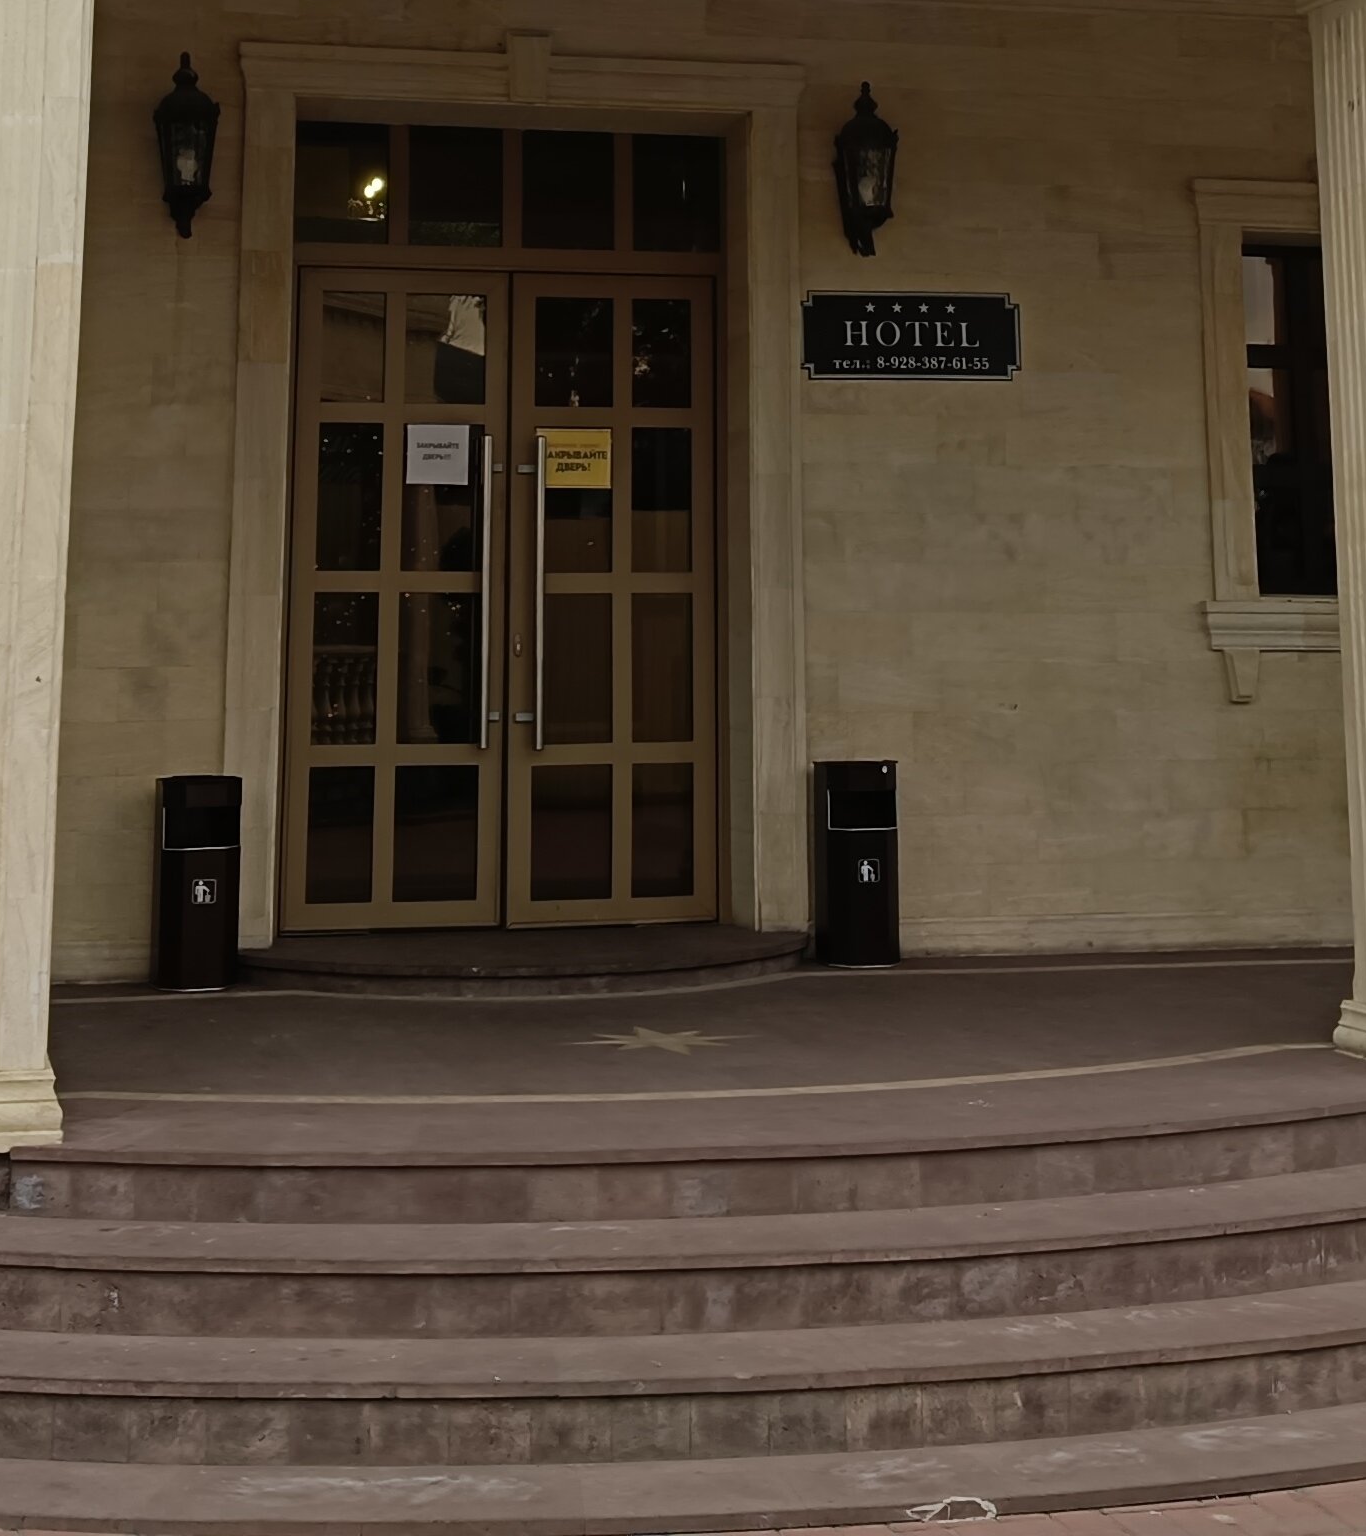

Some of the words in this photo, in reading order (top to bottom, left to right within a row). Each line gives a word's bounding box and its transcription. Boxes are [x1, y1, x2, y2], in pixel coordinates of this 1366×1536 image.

[843, 320, 980, 348] HOTEL
[876, 356, 990, 371] 8-928-387-61-55
[416, 441, 460, 450] ЗАКРЫВАЙТЕ
[546, 448, 608, 460] АКРЫВАЙТЕ
[555, 462, 591, 473] ДВЕРЬ!
